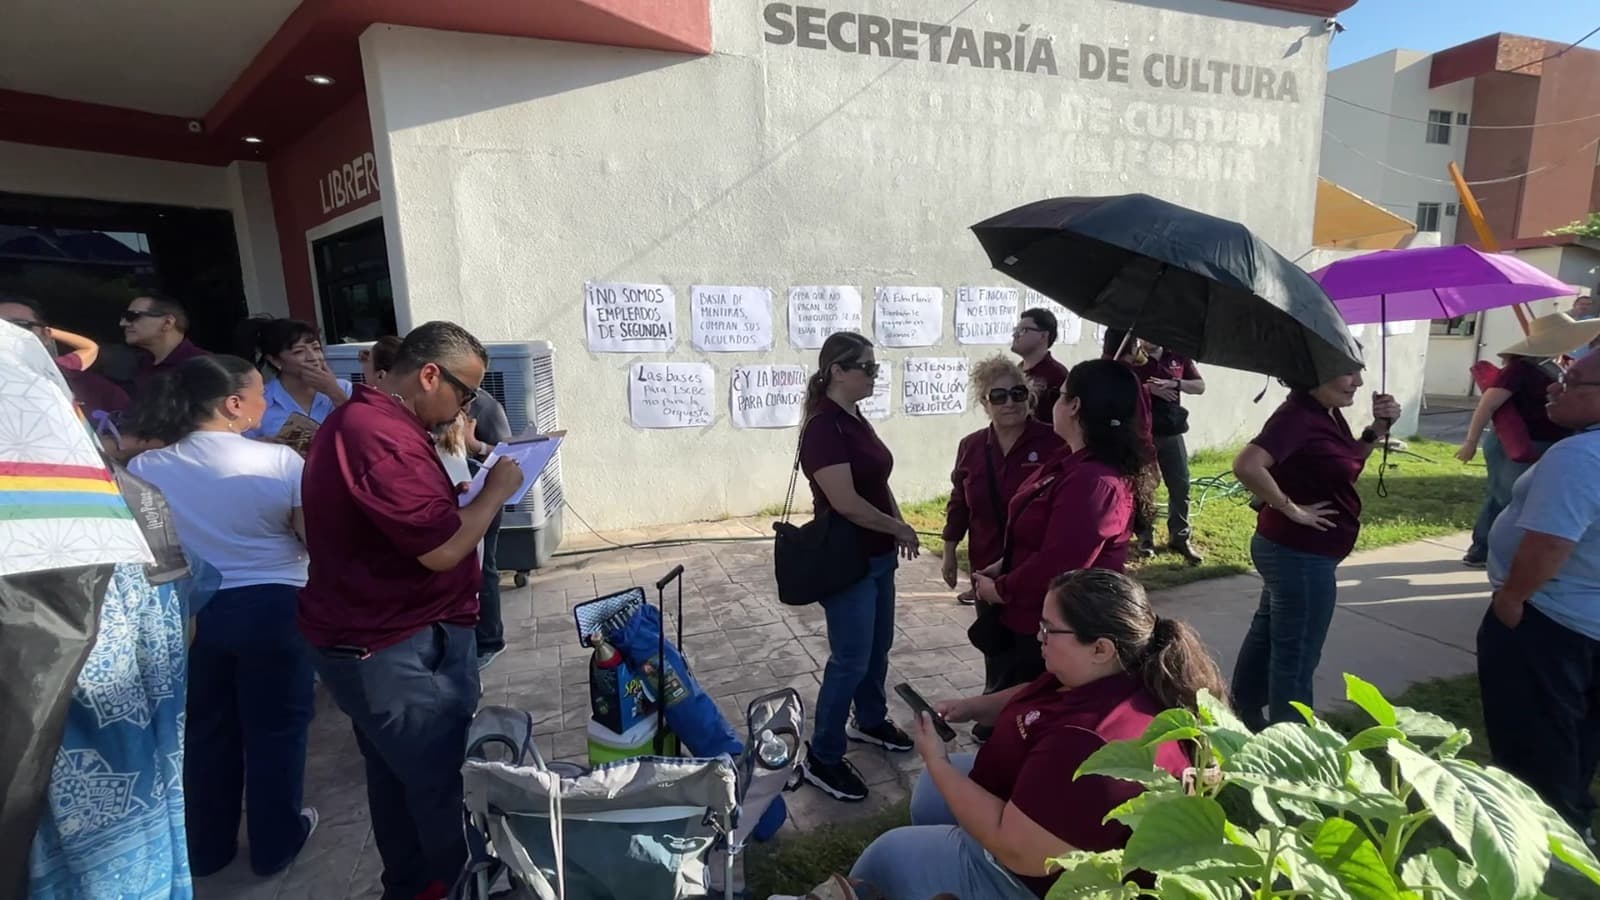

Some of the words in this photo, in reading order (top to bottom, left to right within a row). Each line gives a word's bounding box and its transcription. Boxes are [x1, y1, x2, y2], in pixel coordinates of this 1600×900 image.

[763, 2, 1059, 76] SECRETARÍA
[1079, 43, 1129, 83] DE
[1143, 53, 1299, 102] CULTURA
[320, 152, 380, 214] LIBRER
[622, 288, 664, 303] SOMOS
[700, 293, 727, 305] BASTA
[960, 289, 974, 302] EL
[596, 307, 661, 321] EMPLEADOS
[598, 324, 615, 339] DE
[620, 322, 672, 341] SEGUNDA!
[744, 322, 761, 332] SUS
[638, 365, 663, 382] Las
[666, 366, 703, 383] bases
[757, 370, 769, 387] LA
[738, 395, 763, 411] PARA
